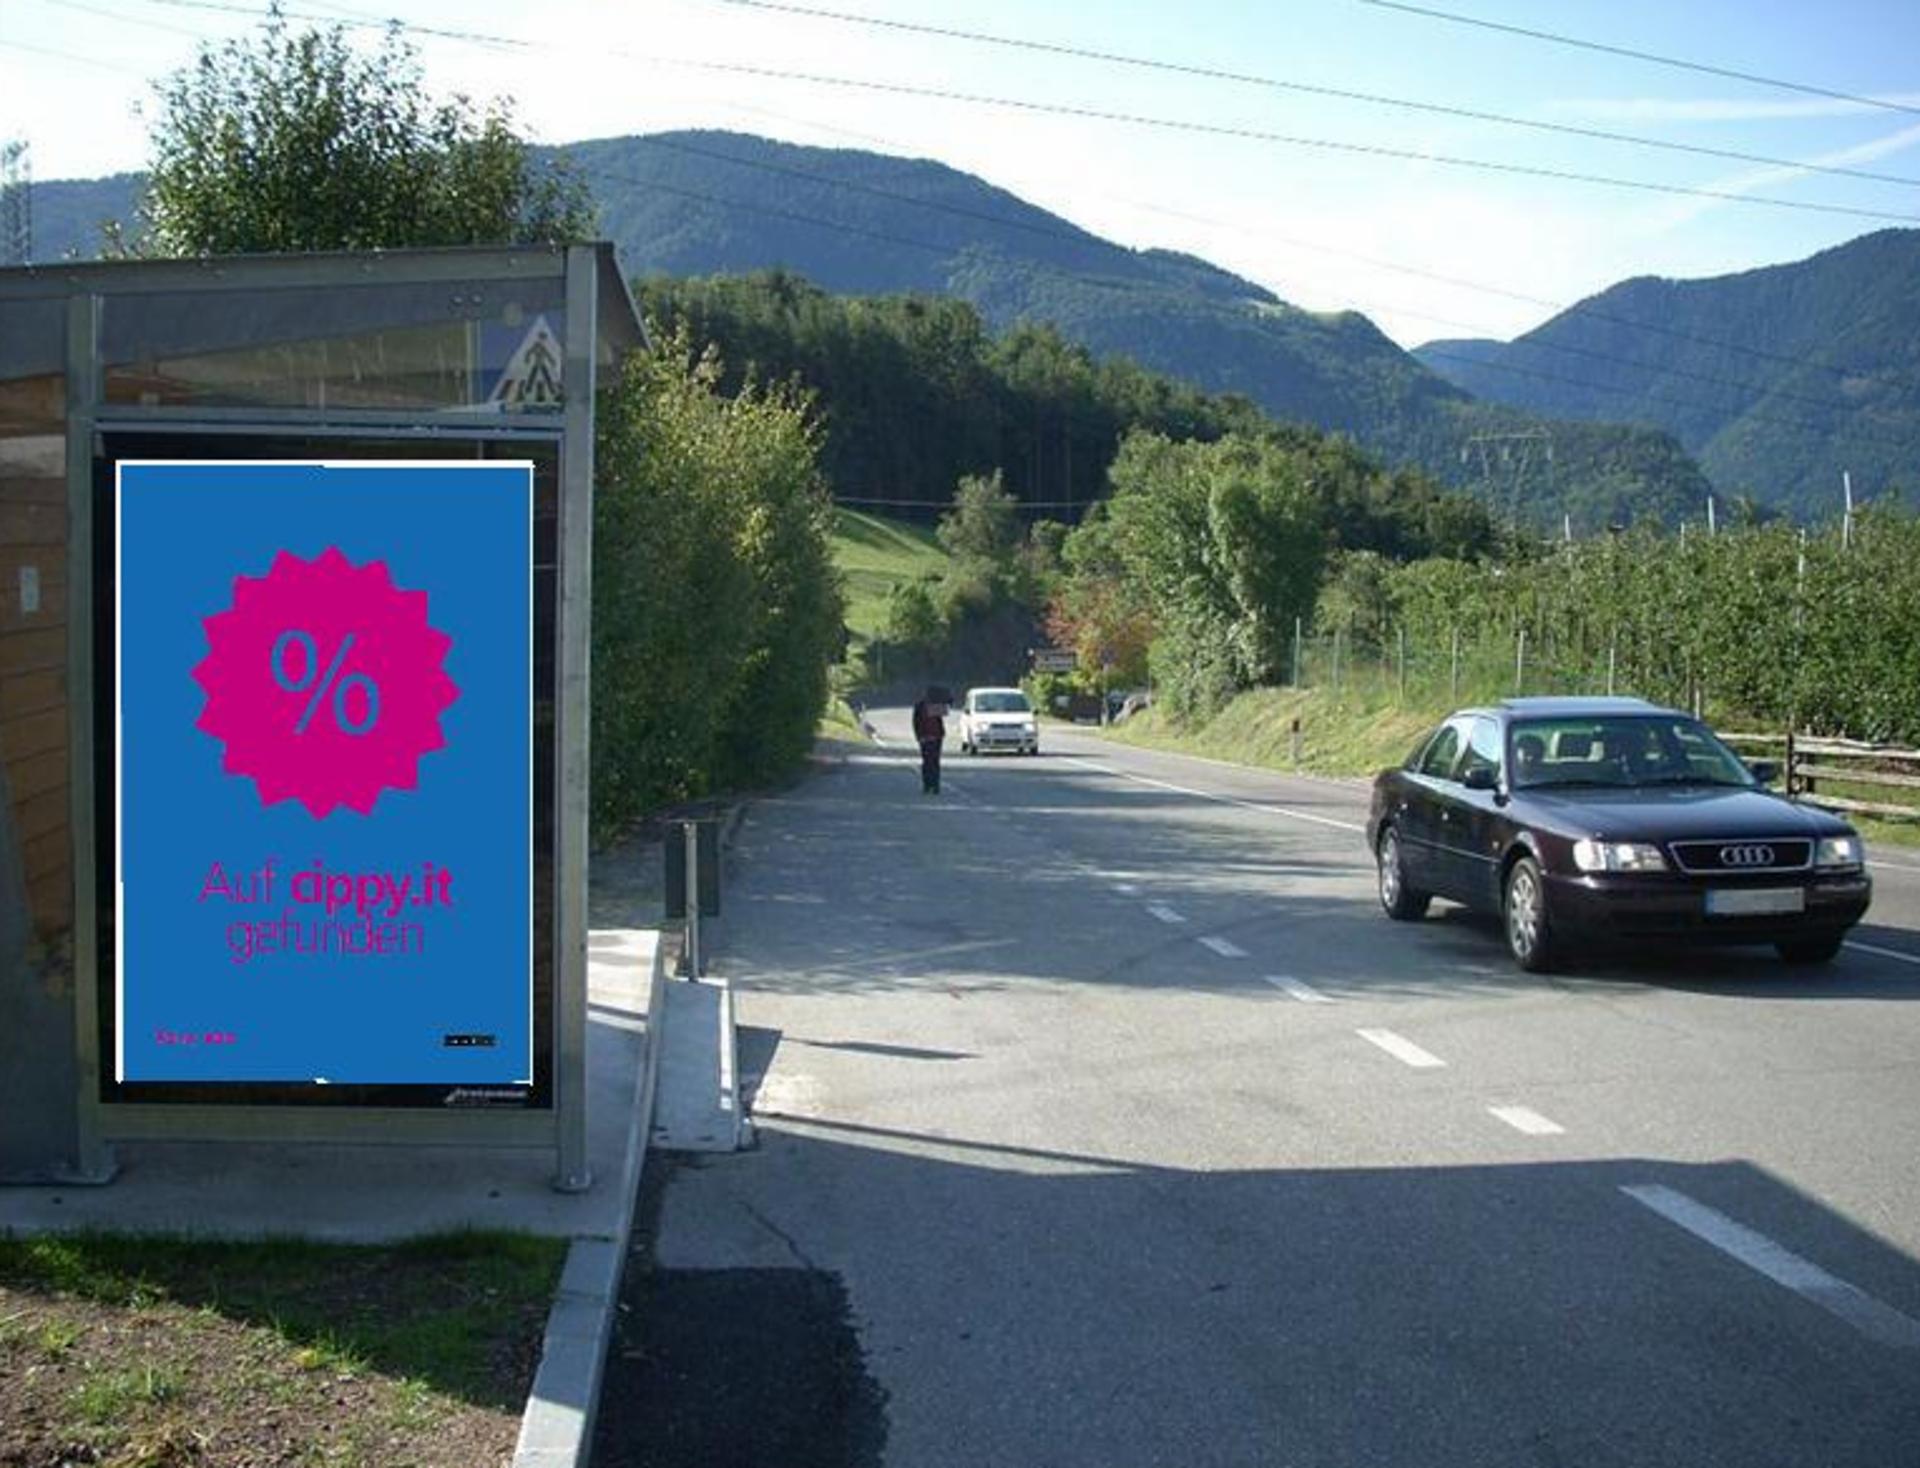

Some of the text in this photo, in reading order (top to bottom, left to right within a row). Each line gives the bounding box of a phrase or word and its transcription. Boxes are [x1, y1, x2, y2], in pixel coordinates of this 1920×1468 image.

[270, 629, 380, 736] %
[198, 857, 453, 917] Auf cippy.it
[225, 907, 425, 964] gefunden
